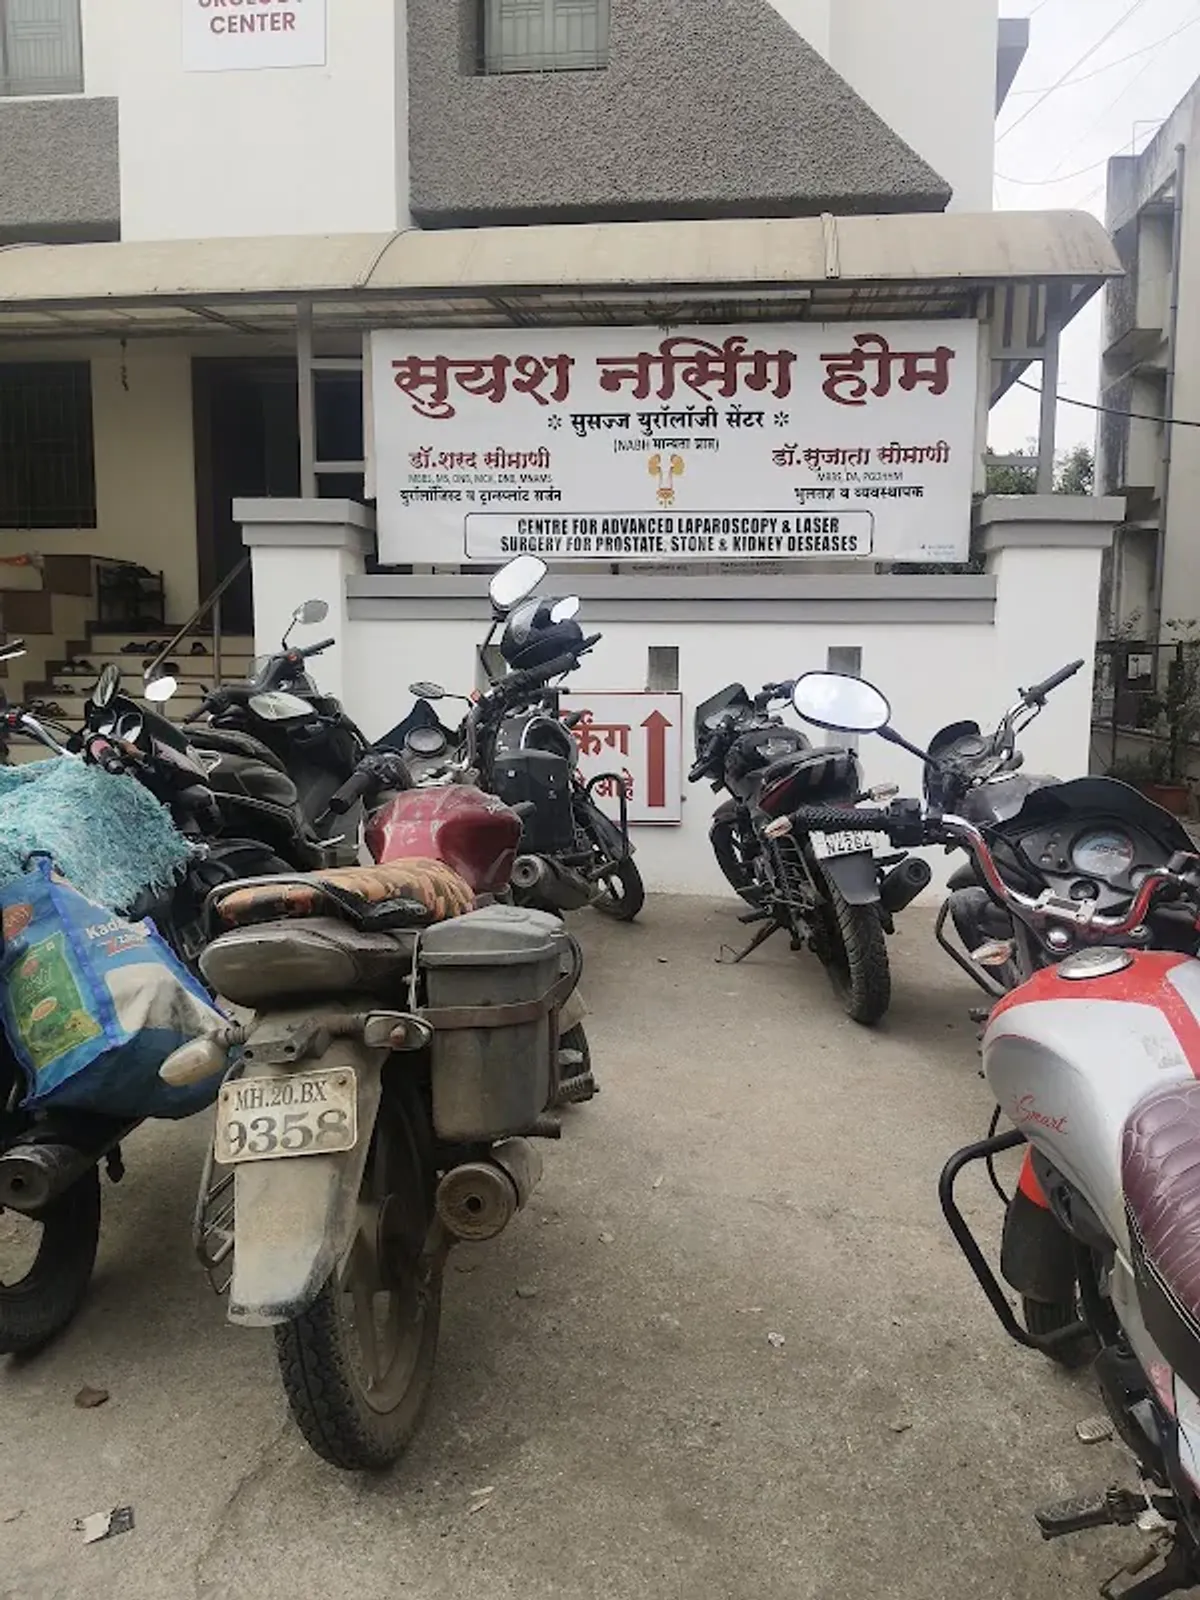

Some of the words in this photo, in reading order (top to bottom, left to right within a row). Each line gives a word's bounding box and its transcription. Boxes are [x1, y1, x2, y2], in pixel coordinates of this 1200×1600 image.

[210, 12, 296, 34] CENTER
[392, 354, 575, 419] सुयश
[596, 336, 797, 401] नर्सिंग
[820, 332, 956, 406] होम
[570, 413, 631, 437] सुसज्ज
[637, 405, 719, 436] युरॉलॉजी
[725, 404, 765, 429] सेंटर
[518, 518, 568, 535] CENTRE
[573, 518, 597, 535] FOR
[602, 518, 673, 535] ADVANCED
[678, 517, 777, 534] LAPAROSCOPY
[782, 519, 791, 534] &
[796, 517, 840, 534] LASER
[501, 536, 562, 552] SURGERY
[566, 536, 591, 551] FOR
[596, 536, 667, 552] PROSTATE,
[672, 536, 714, 551] STONE
[719, 537, 728, 551] &
[733, 536, 783, 551] KIDNEY
[788, 536, 858, 551] DESEASES
[235, 1079, 328, 1111] MH.20.BX
[1013, 1093, 1069, 1135] Smart
[222, 1109, 350, 1156] 9358
